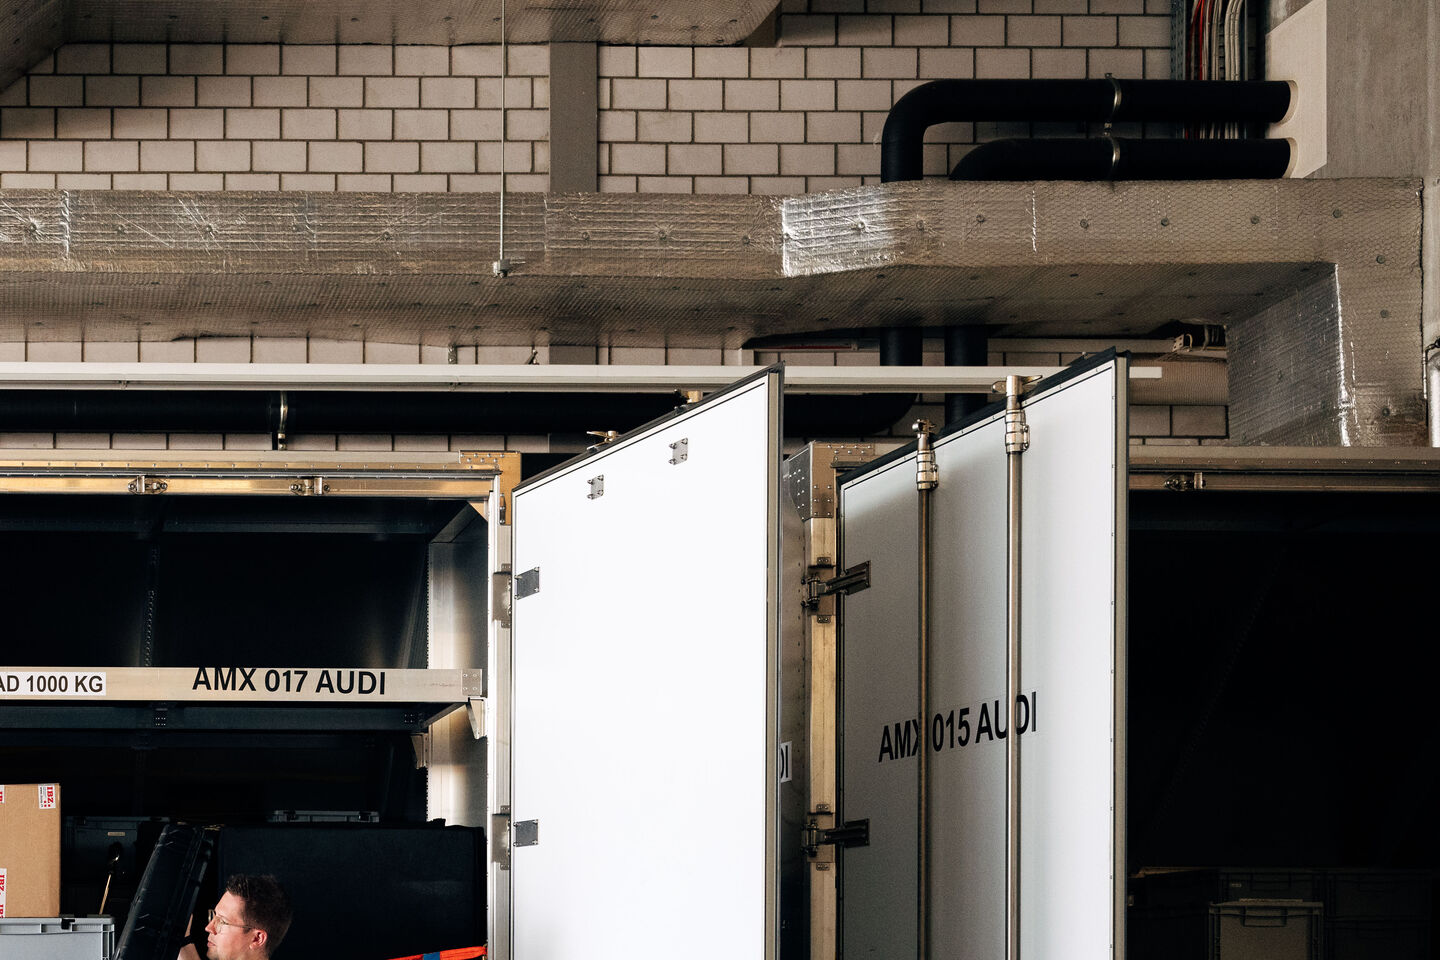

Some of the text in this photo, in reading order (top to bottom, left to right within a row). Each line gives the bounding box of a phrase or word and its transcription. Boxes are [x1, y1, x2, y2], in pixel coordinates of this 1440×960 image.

[26, 675, 69, 693] 1000
[74, 675, 103, 693] KG
[192, 667, 386, 695] AMX 017 AUDI
[932, 706, 971, 752] 015
[975, 691, 1037, 744] AUDI
